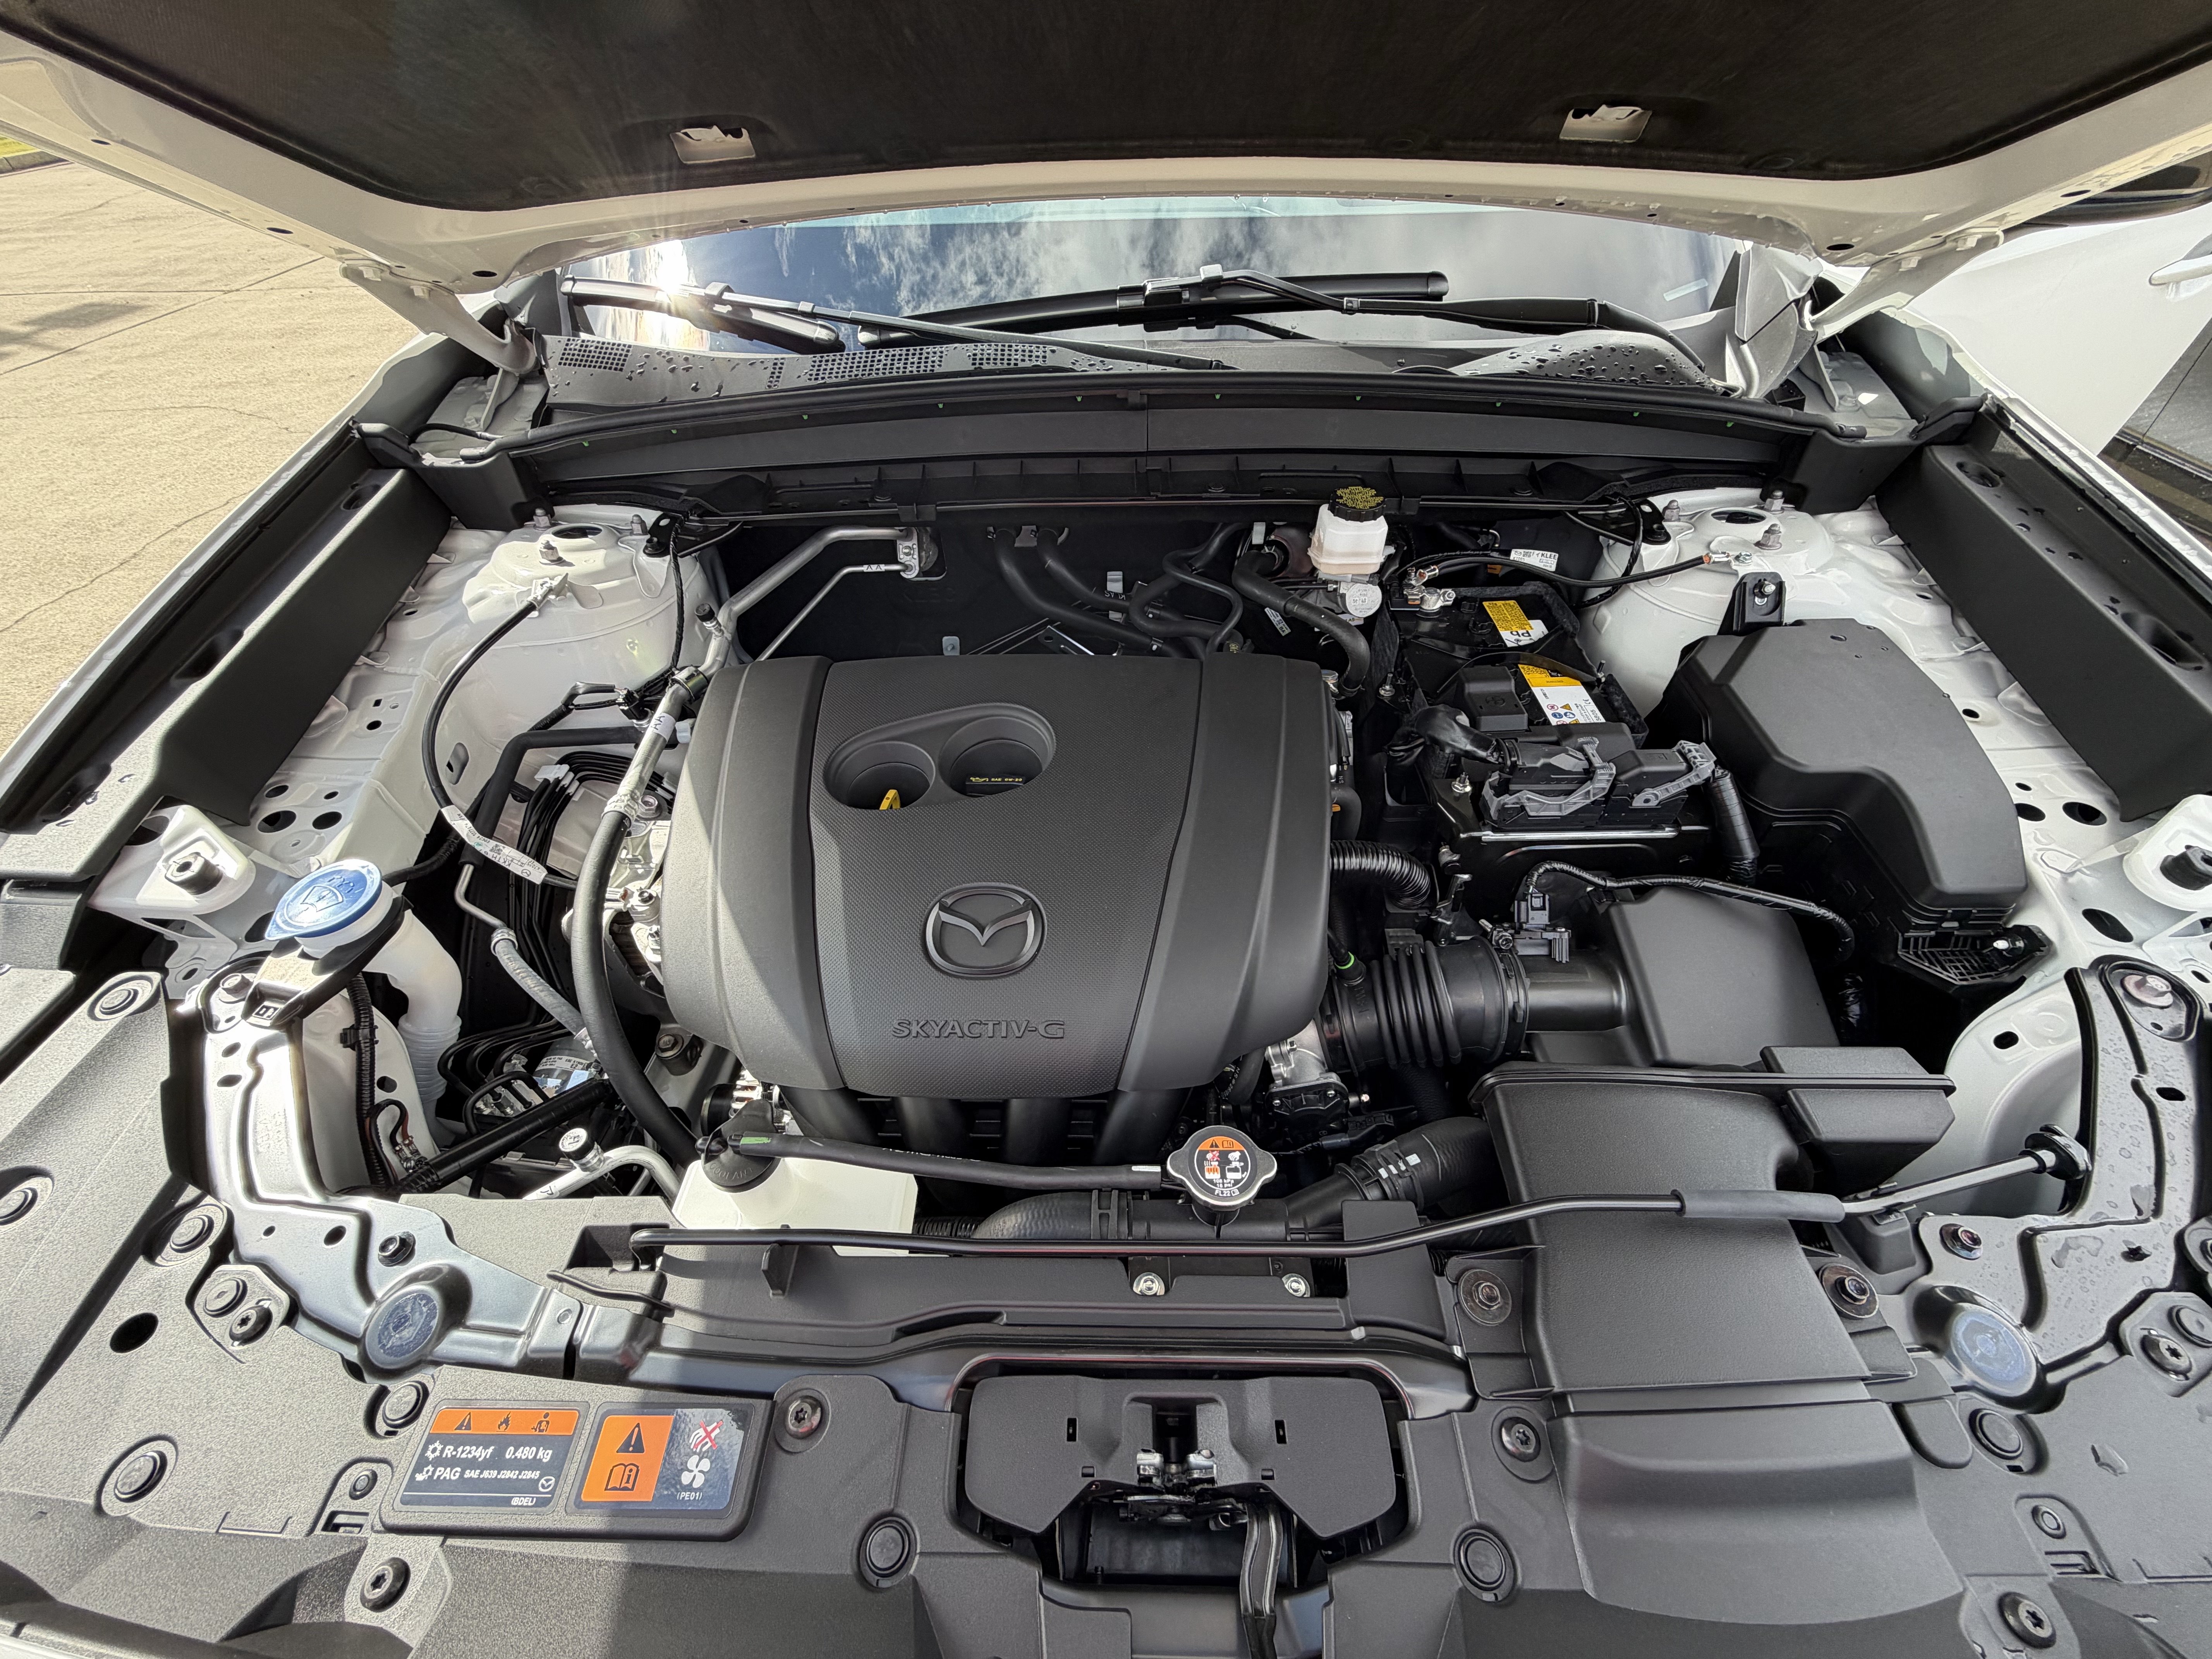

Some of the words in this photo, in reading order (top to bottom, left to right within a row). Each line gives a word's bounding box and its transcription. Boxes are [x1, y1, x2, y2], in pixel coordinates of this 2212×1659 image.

[891, 1019, 1065, 1039] SKYACTIV-G
[442, 1446, 495, 1461] R-1234yf
[505, 1446, 536, 1459] 0.480
[536, 1447, 553, 1462] kg
[433, 1467, 461, 1480] PAG
[464, 1470, 481, 1478] SAE
[480, 1470, 498, 1479] J639
[497, 1470, 518, 1479] J2842
[511, 1497, 536, 1506] (BDEL)
[677, 1492, 702, 1500] (PE01)
